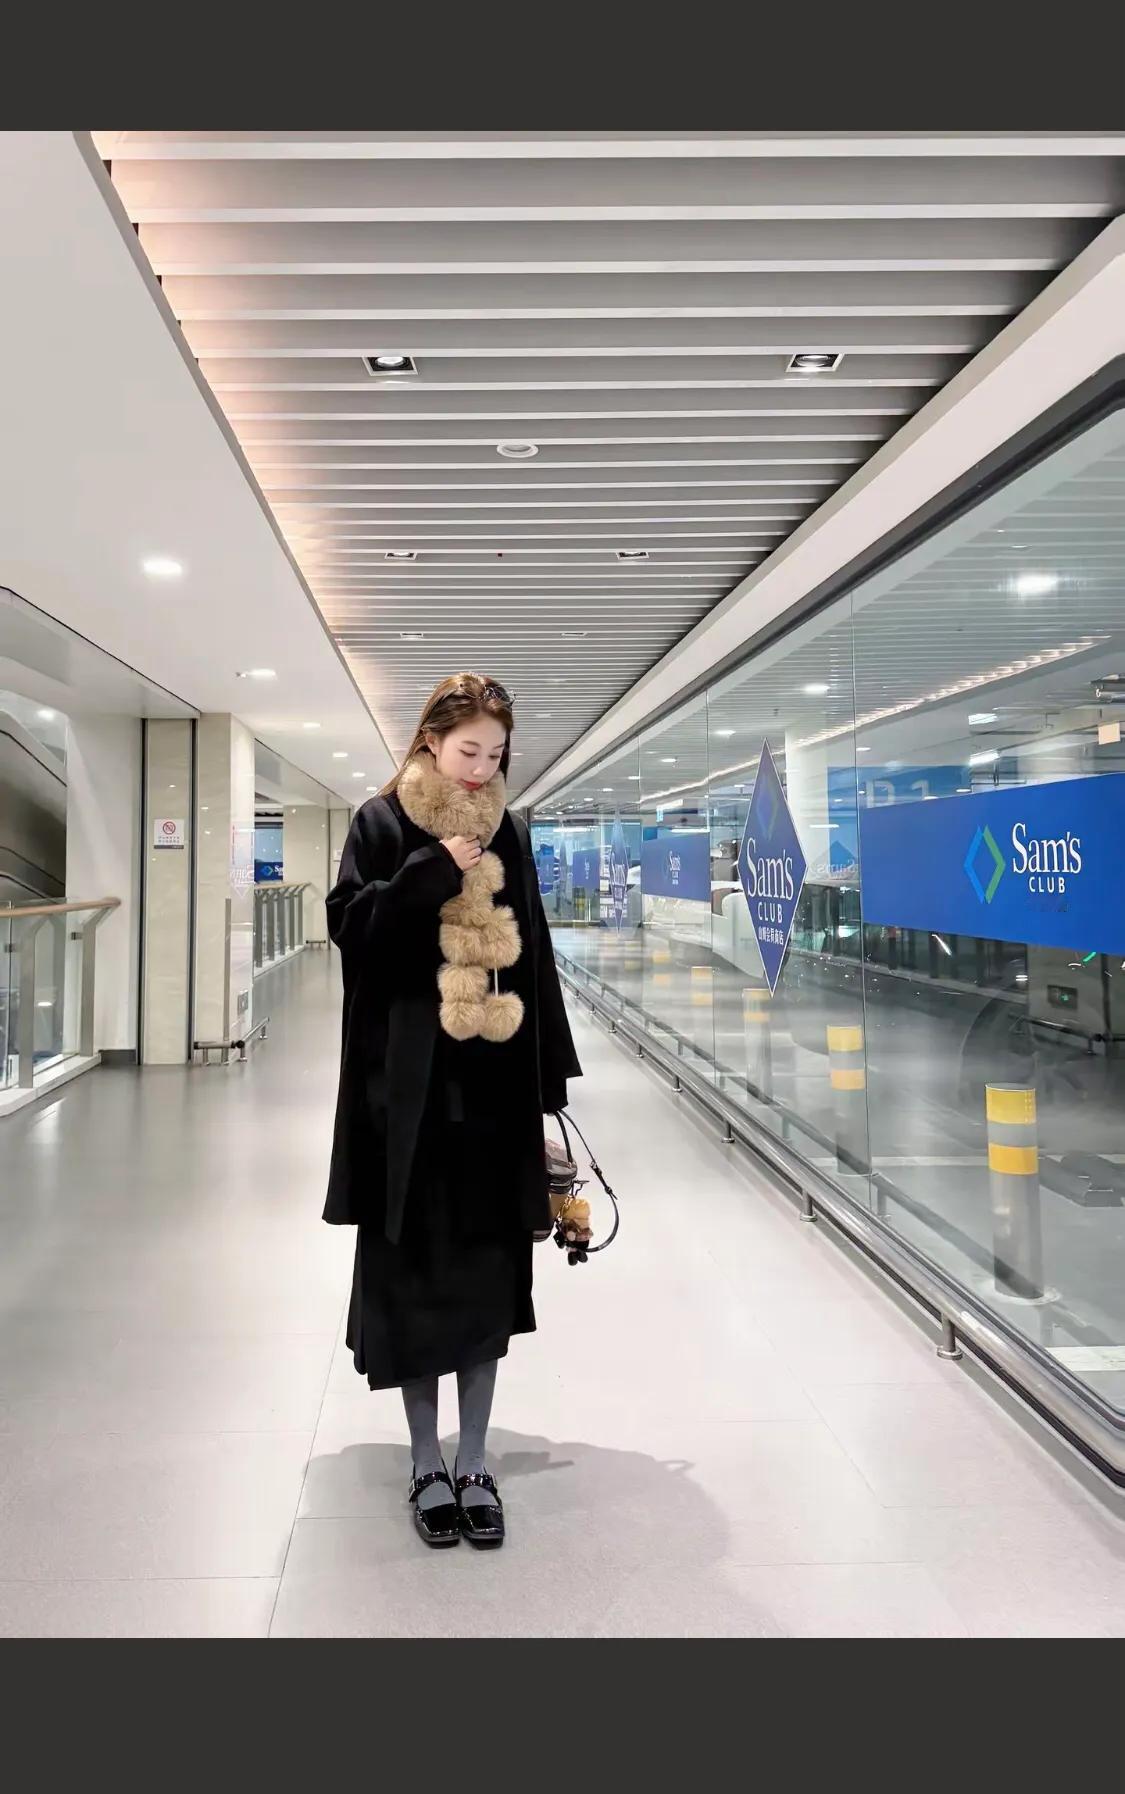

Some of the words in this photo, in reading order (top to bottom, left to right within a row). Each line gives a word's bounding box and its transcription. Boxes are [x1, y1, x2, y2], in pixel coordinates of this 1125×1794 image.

[1012, 822, 1082, 874] Sam's
[746, 837, 794, 901] Sam's
[1028, 876, 1066, 894] CLUB
[757, 901, 783, 924] CLUB
